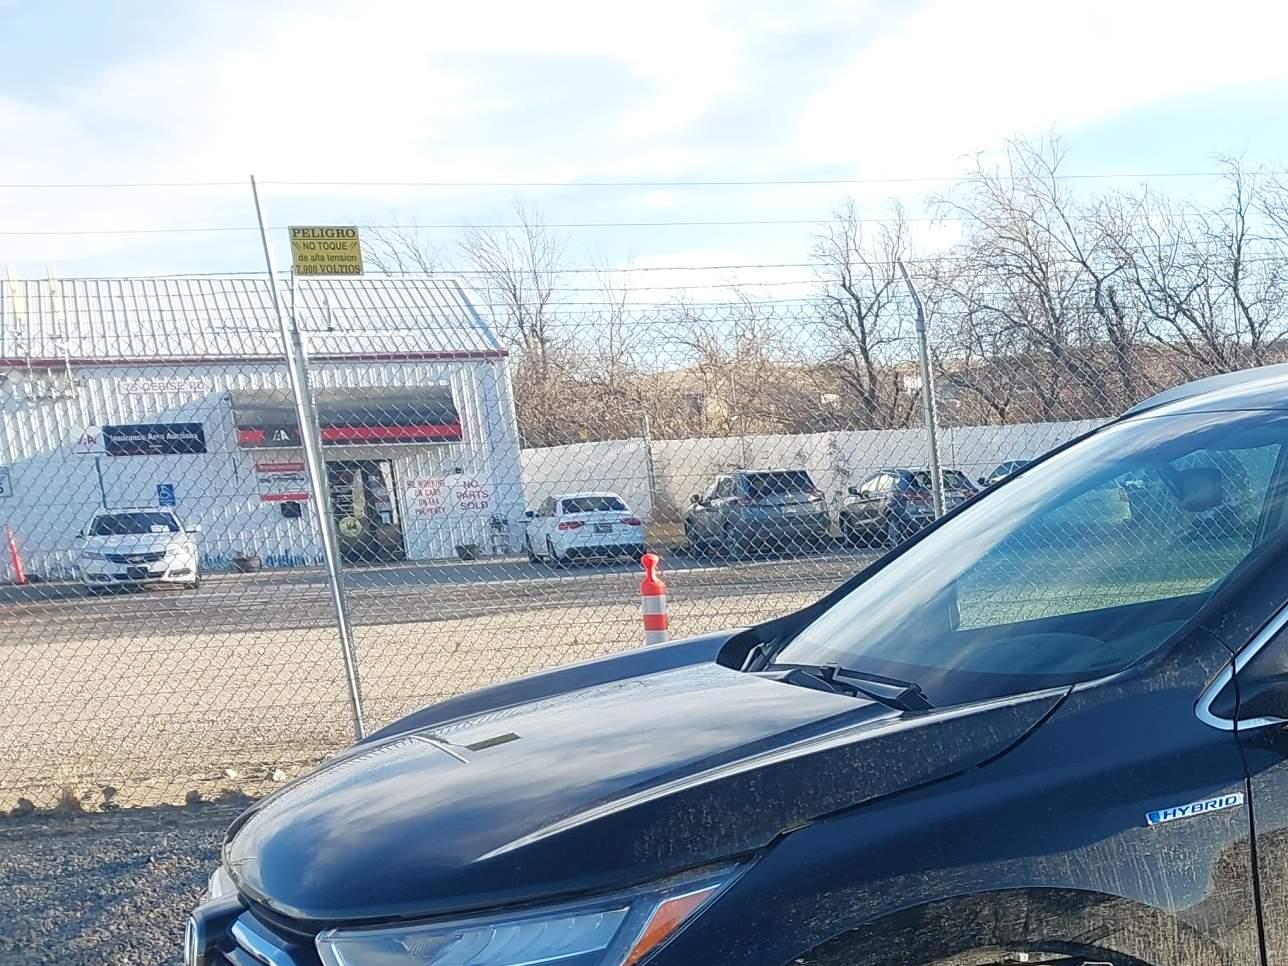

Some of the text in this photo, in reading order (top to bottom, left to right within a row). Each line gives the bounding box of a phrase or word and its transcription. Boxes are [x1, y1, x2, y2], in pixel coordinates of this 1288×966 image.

[292, 228, 356, 238] PELIGRO
[302, 241, 348, 250] NO TOQUE
[298, 253, 308, 262] de
[311, 252, 325, 262] alta
[320, 264, 360, 273] VOLTIOS
[463, 480, 479, 488] NO
[456, 490, 489, 500] PARTS
[460, 500, 488, 511] SOLD
[1163, 795, 1238, 820] HYBRID
